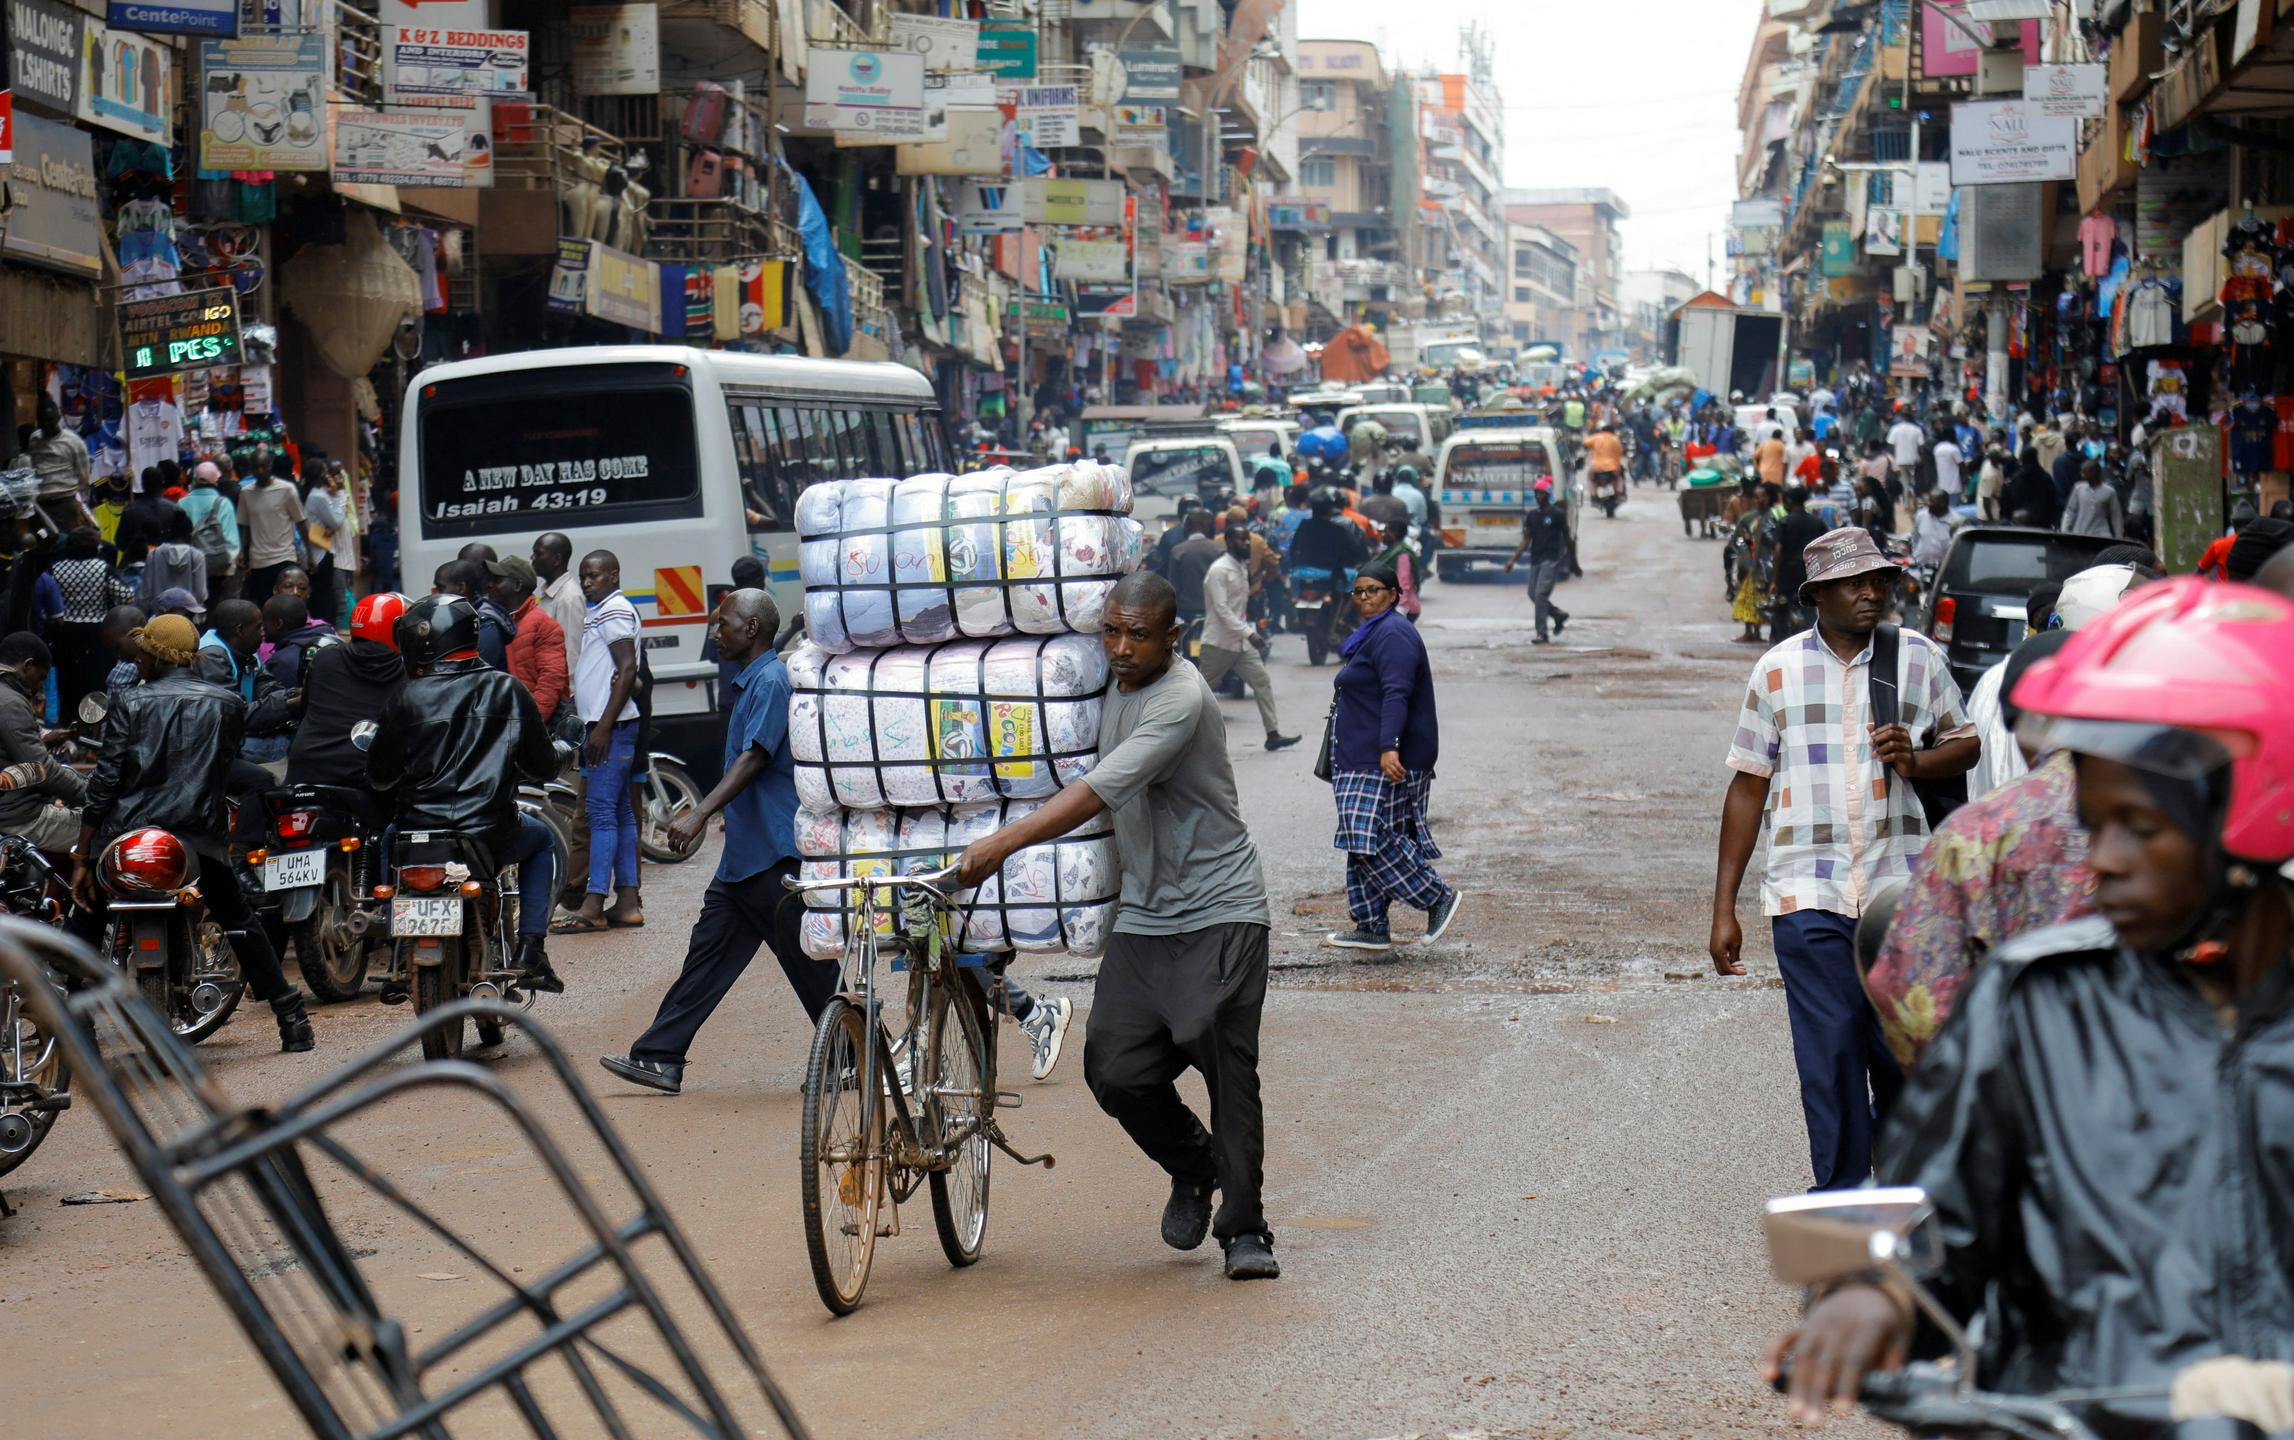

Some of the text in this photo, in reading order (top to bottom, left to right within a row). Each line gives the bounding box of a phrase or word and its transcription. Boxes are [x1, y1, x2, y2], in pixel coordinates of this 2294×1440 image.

[125, 6, 218, 28] CentePoint
[400, 28, 526, 49] K & Z BEDDINGS
[400, 46, 425, 56] AND
[16, 49, 72, 102] T.SHIRTS
[463, 455, 648, 491] A NEW DAY HAS COME
[436, 488, 607, 519] Isaiah 43:19
[287, 854, 311, 870] UMA
[279, 868, 319, 886] 564KV
[417, 900, 451, 916] UFX
